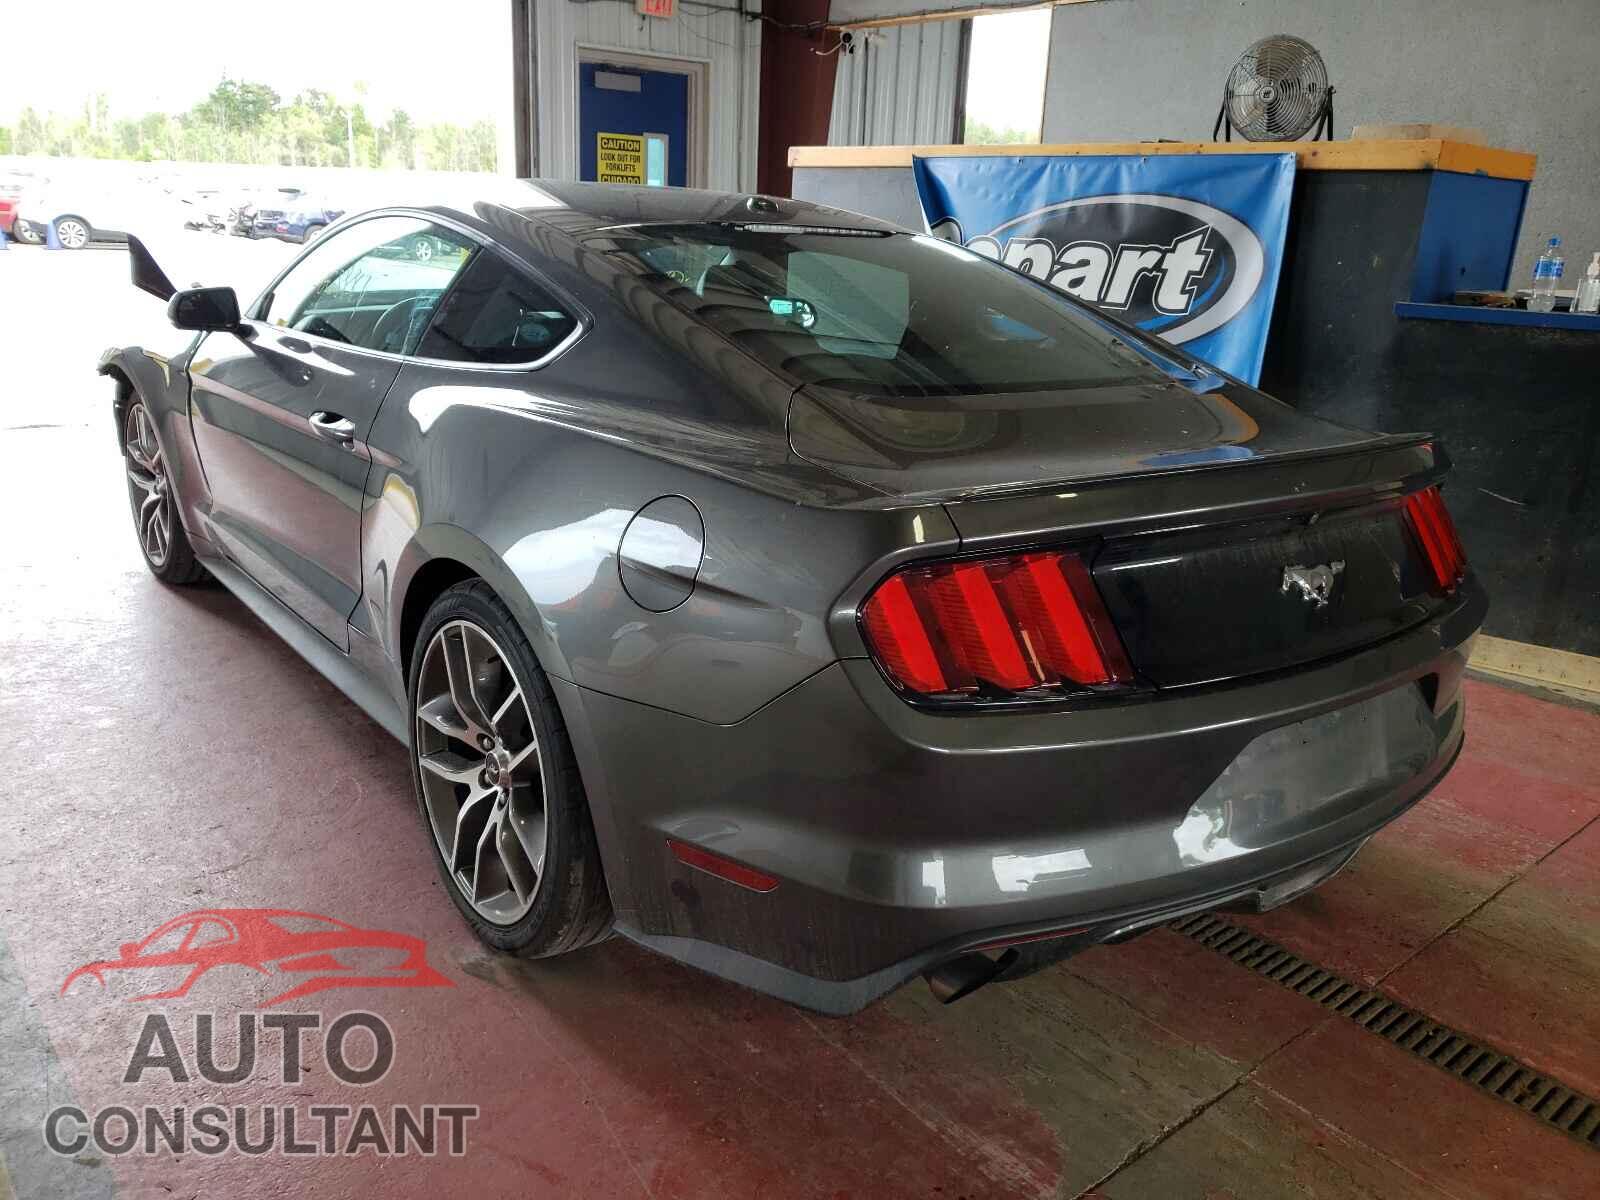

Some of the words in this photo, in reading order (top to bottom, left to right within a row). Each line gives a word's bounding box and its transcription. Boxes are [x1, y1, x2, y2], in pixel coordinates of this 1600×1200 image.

[601, 138, 640, 151] CAUTION
[601, 152, 616, 161] LOOK
[617, 154, 629, 163] OUT
[630, 155, 640, 164] FOR
[605, 163, 636, 172] FORKLIFTS
